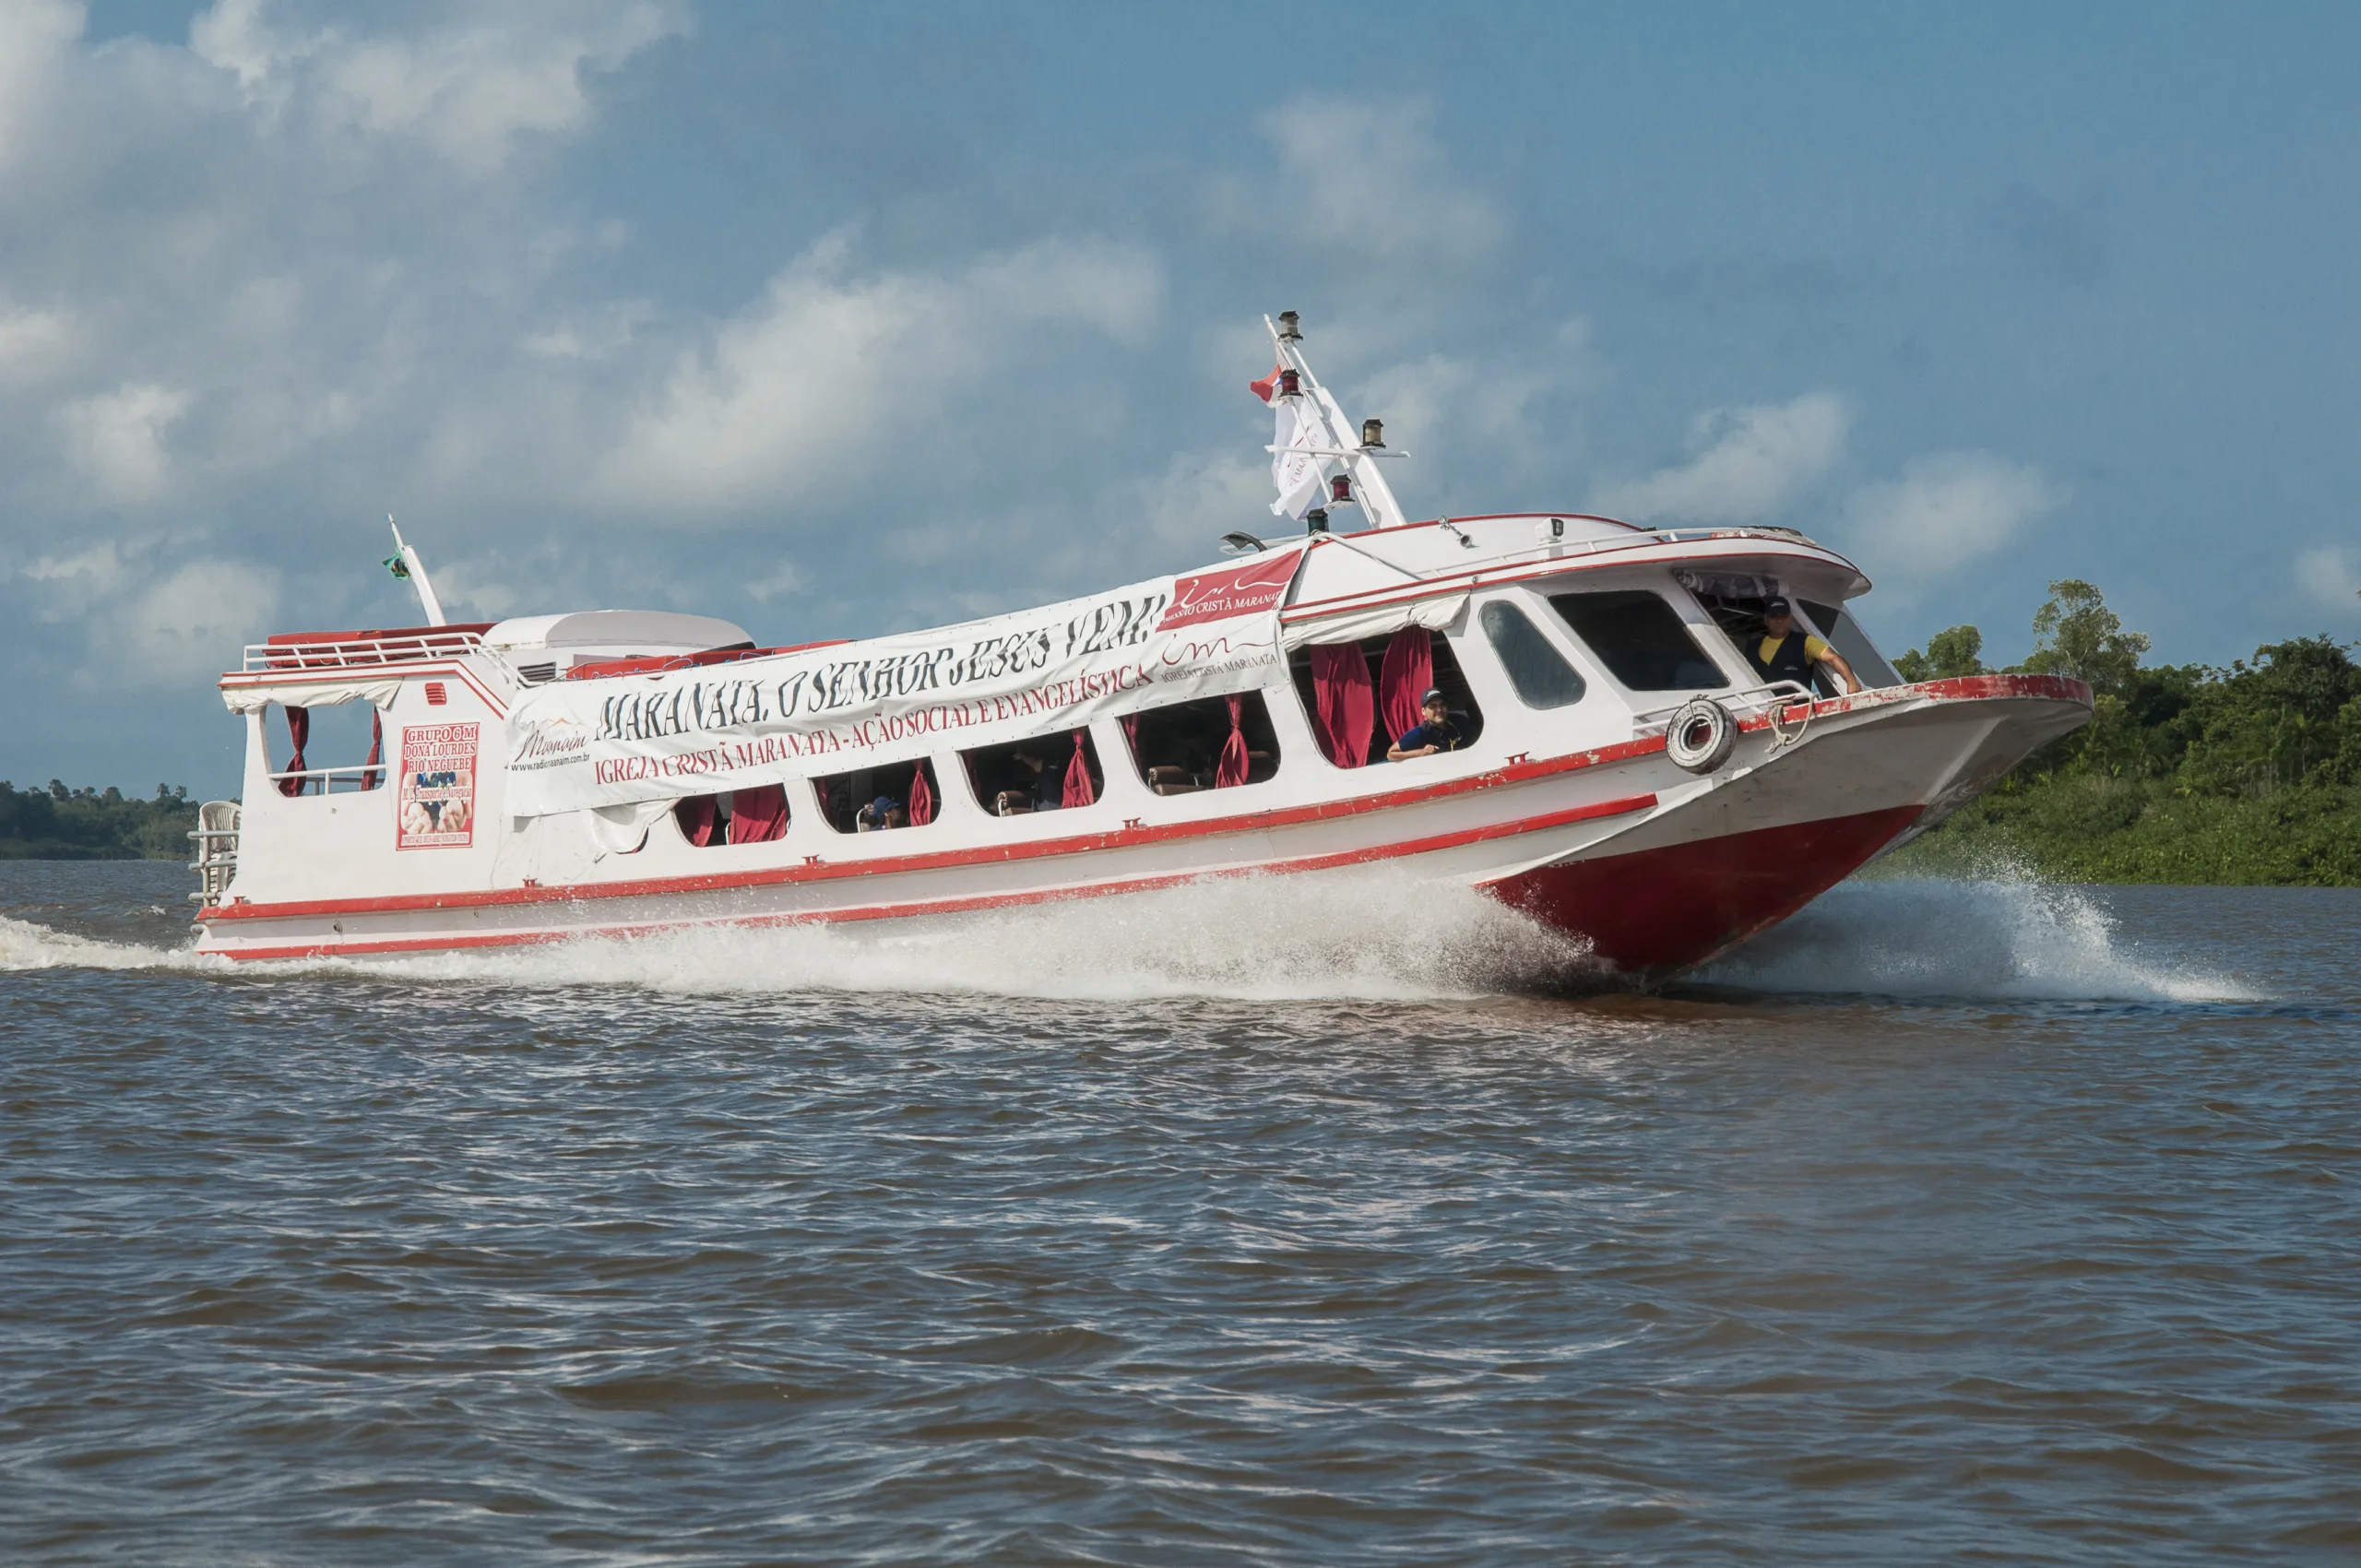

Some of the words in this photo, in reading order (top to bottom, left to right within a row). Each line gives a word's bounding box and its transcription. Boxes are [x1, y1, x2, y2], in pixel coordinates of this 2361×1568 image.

[1196, 597, 1232, 614] CRISTÃ
[594, 679, 769, 742] MARANATA,
[777, 671, 808, 718] O
[808, 647, 954, 714] SENHOR
[949, 624, 1061, 686] JESUS
[1066, 594, 1166, 659] VEM!
[1161, 668, 1194, 683] IGREJA
[1225, 653, 1277, 672] MARANATA
[595, 755, 659, 784] IGREJA
[662, 741, 734, 777] CRISTÃ
[735, 727, 841, 768] MARANATA
[852, 712, 903, 752] AÇÃO
[905, 701, 978, 737] SOCIAL
[977, 698, 992, 723] E
[992, 663, 1155, 721] EVANGELÍSTICA
[408, 728, 451, 742] GRUPO
[454, 728, 460, 740] 6
[464, 727, 475, 739] M
[406, 744, 431, 757] DONA
[433, 742, 476, 756] LOURDES
[408, 759, 425, 773] RIO
[427, 757, 471, 772] NEGUEBE
